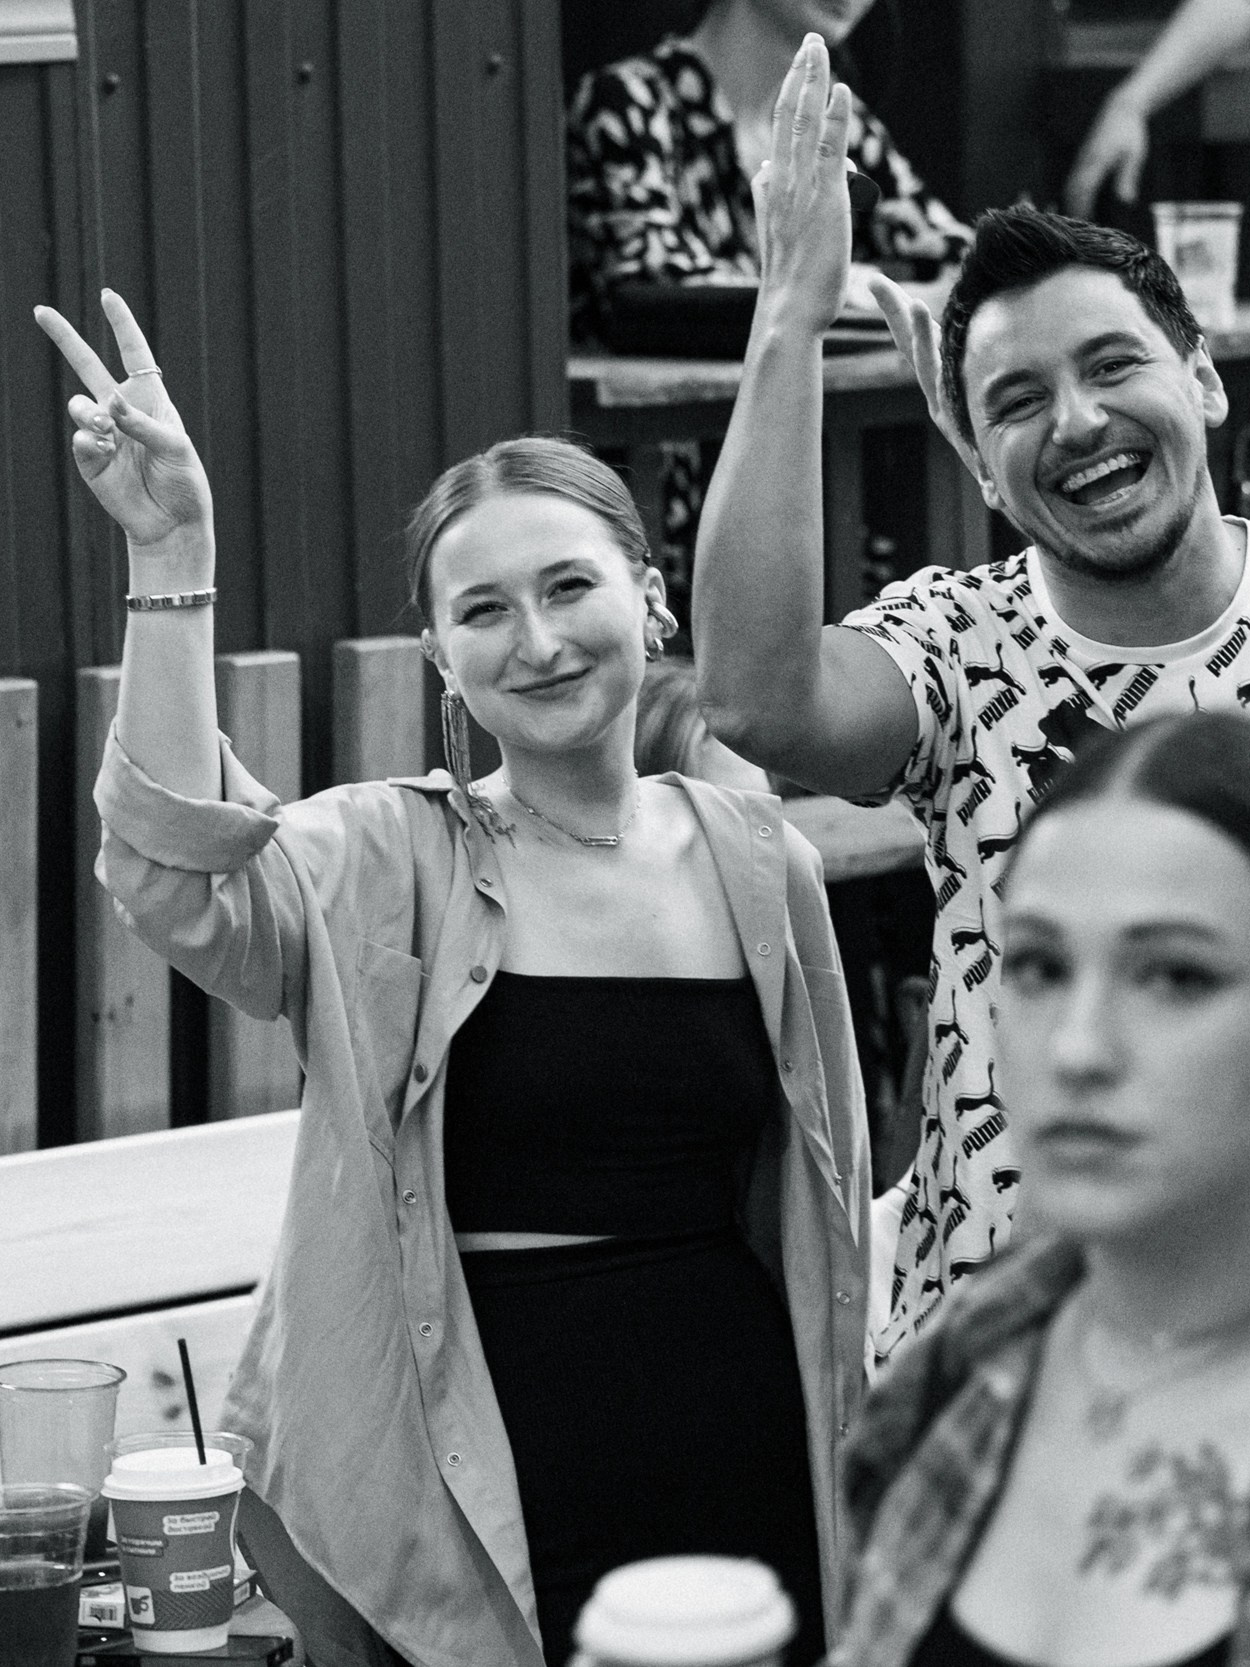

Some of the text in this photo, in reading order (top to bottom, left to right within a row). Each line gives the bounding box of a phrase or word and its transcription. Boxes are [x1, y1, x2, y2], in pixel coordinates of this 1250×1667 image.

[1205, 626, 1248, 678] PUMA
[1112, 665, 1159, 722] PUMA
[962, 949, 993, 992] PUMA
[962, 1111, 1009, 1160] PUMA
